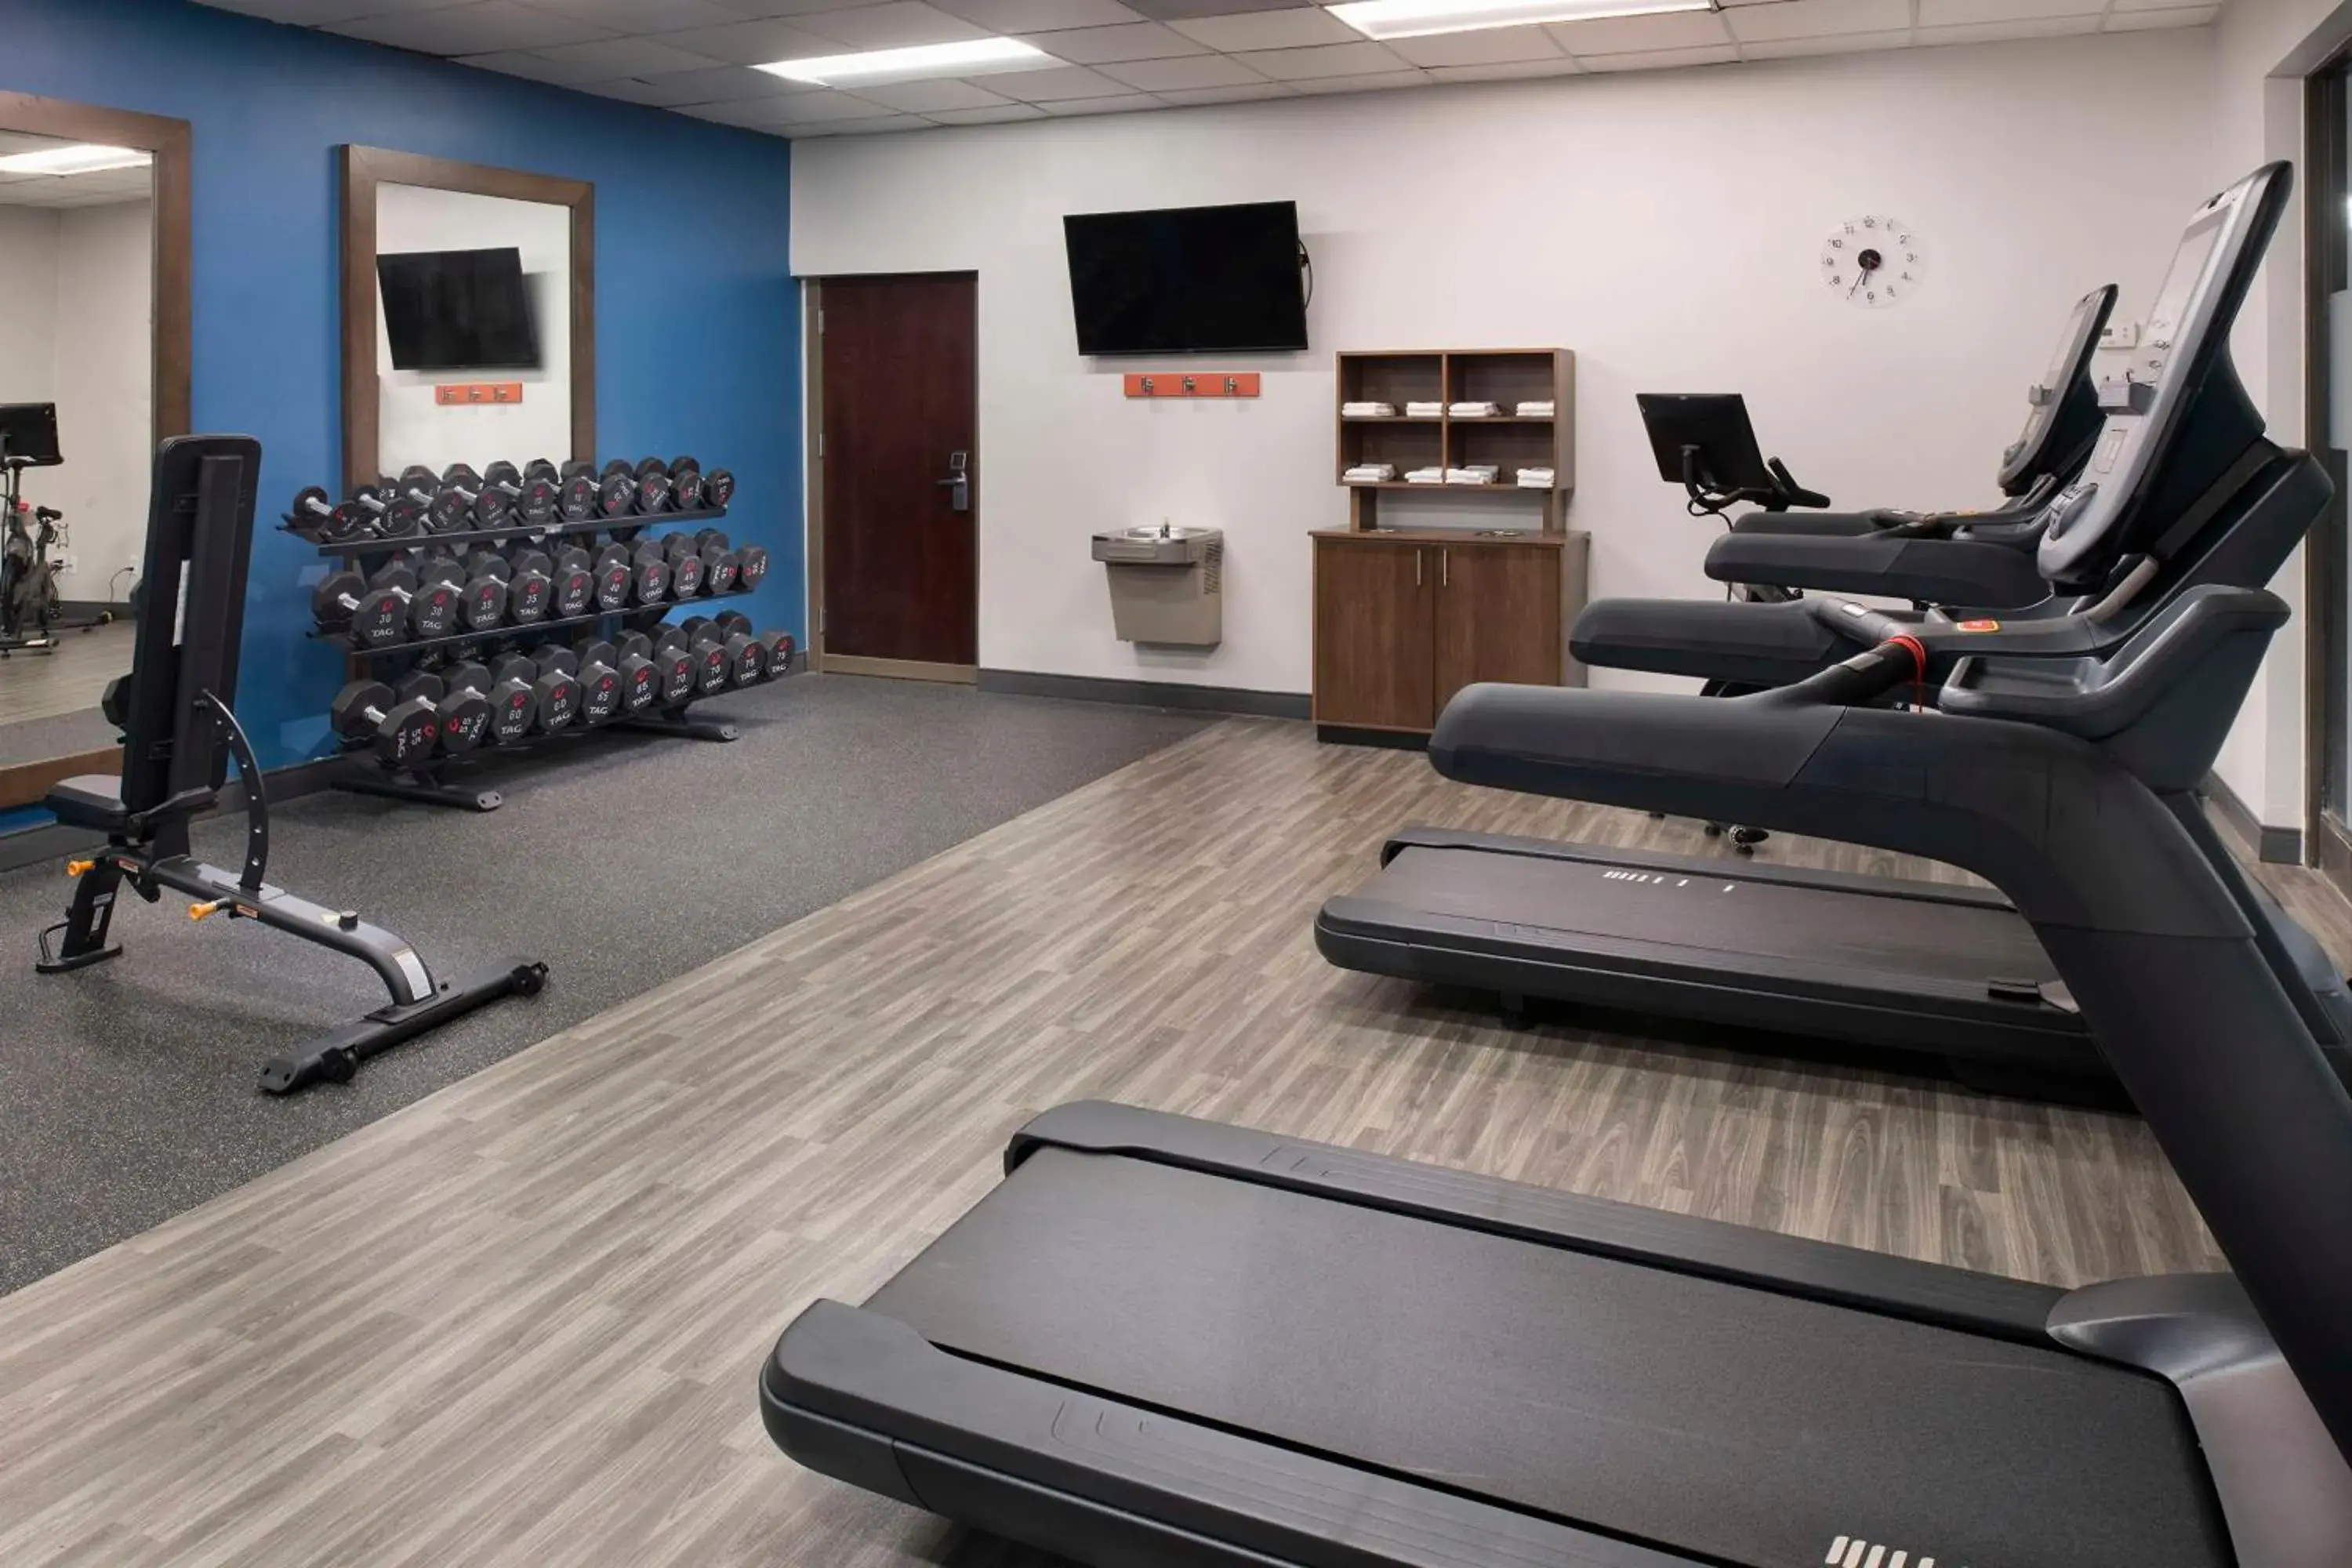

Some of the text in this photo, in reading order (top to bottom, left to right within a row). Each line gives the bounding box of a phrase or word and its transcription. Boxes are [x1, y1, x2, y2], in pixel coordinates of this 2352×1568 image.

[1900, 234, 1907, 244] 2
[1826, 257, 1834, 266] 9
[1906, 252, 1914, 262] 3
[603, 595, 619, 604] TAG
[481, 601, 492, 611] 35
[564, 601, 583, 610] TAG
[431, 606, 443, 616] 30
[520, 607, 539, 616] TAG
[379, 614, 392, 625] 30
[476, 613, 496, 623] TAG
[423, 620, 442, 630] TAG
[371, 629, 394, 637] TAG
[710, 665, 720, 676] 70
[771, 665, 787, 673] TAG
[677, 674, 686, 684] 70
[740, 671, 757, 681] TAG
[705, 677, 724, 689] TAG
[597, 691, 609, 702] 65
[670, 686, 688, 697] TAG
[554, 698, 567, 711] 60
[632, 693, 652, 707] TAG
[509, 710, 522, 720] 60
[589, 706, 608, 715] TAG
[549, 711, 572, 726] TAG
[468, 713, 485, 741] TAG
[501, 724, 522, 735] TAG
[411, 727, 422, 745] 55
[397, 728, 407, 758] TAG
